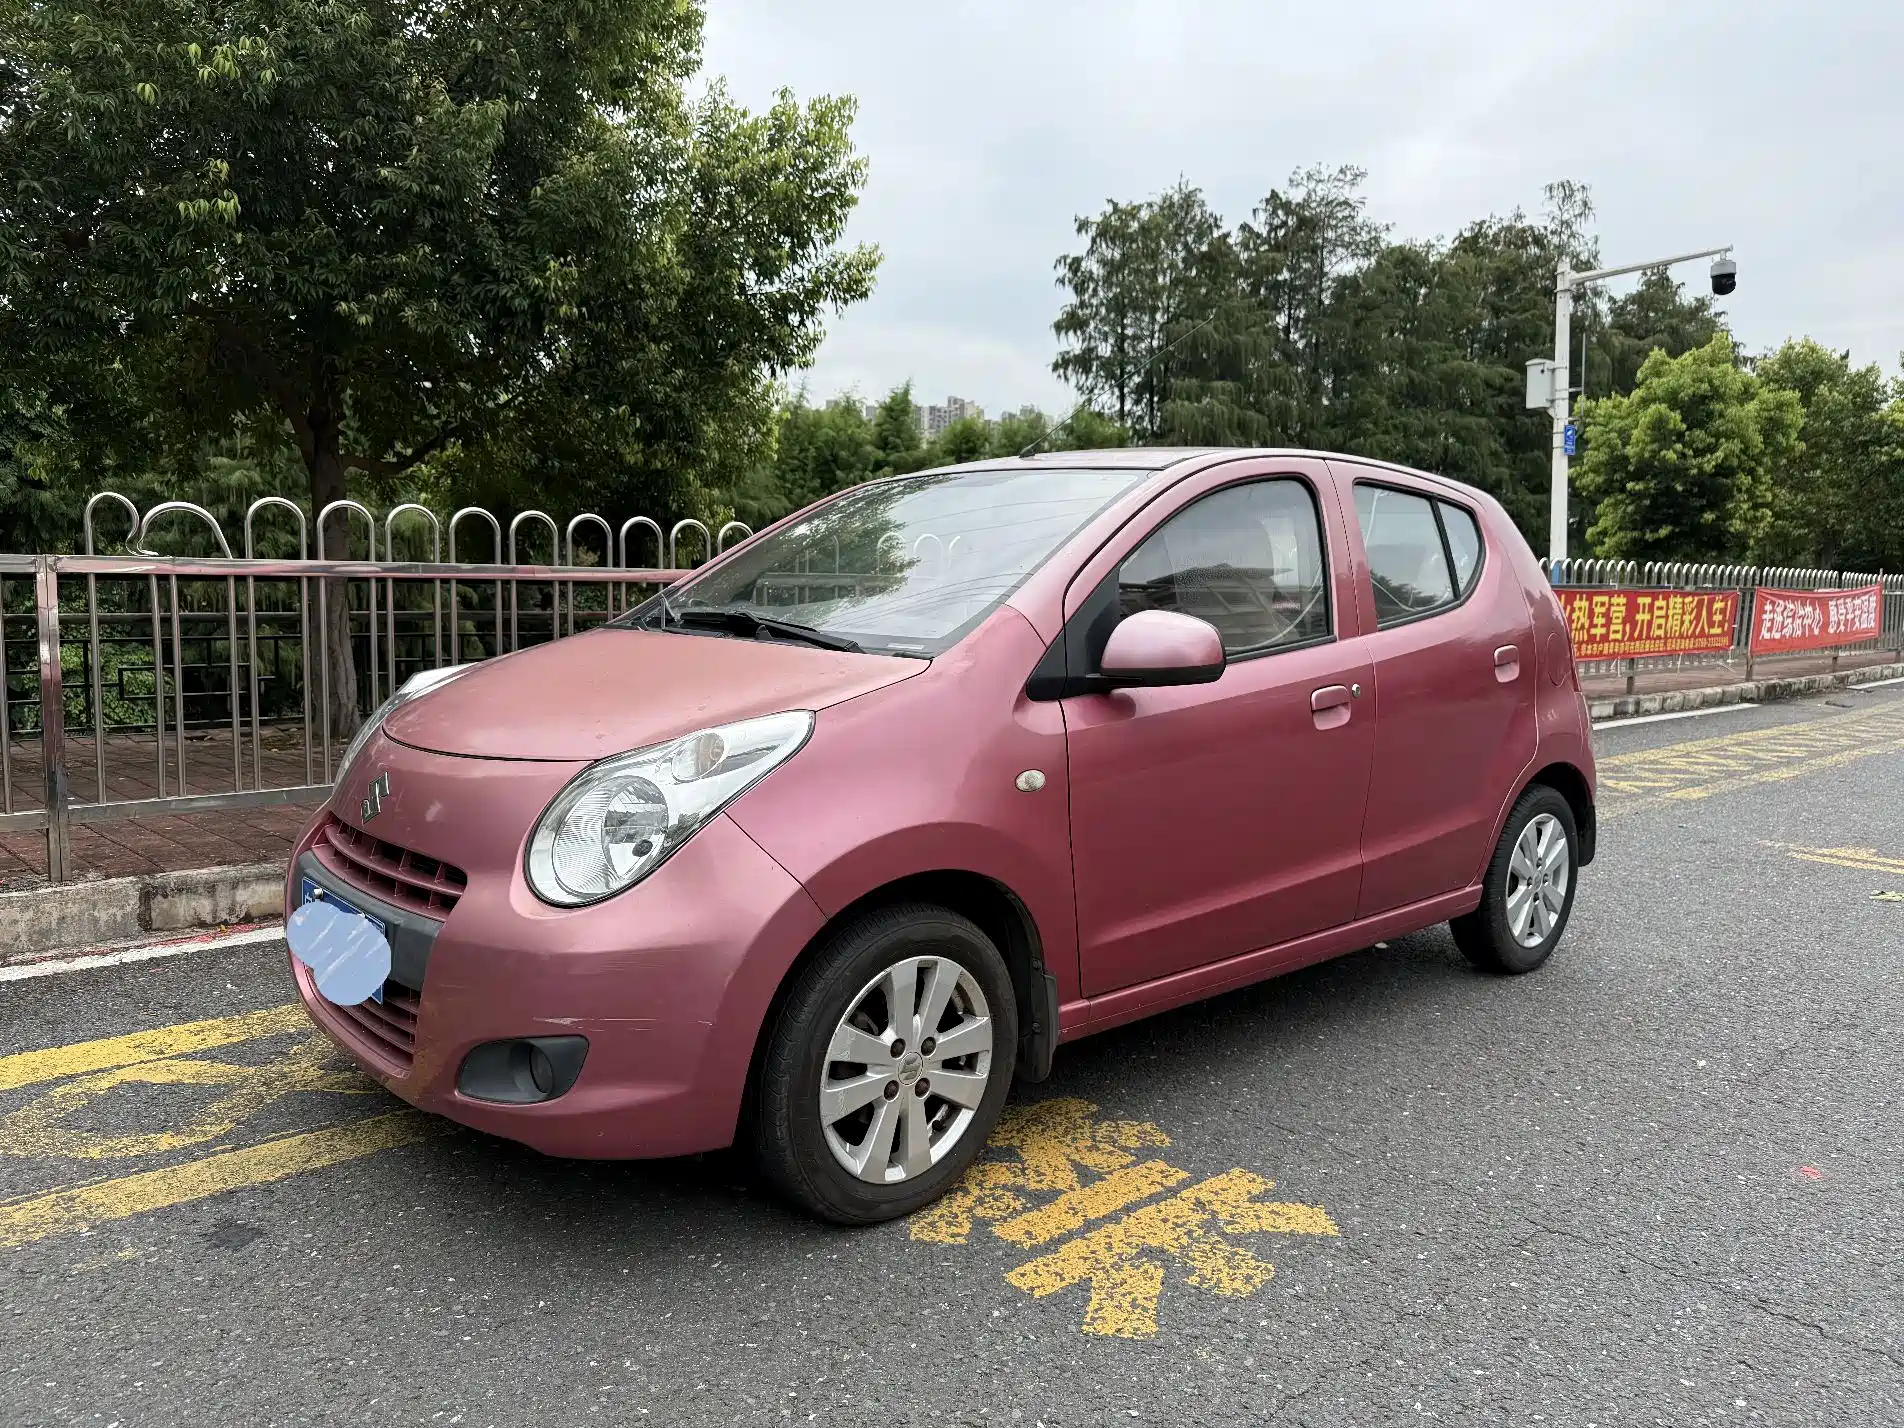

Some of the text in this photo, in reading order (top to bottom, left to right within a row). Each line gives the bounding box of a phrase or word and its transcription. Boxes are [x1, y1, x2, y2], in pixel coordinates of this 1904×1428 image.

[1759, 599, 1823, 640] 走进综治中心
